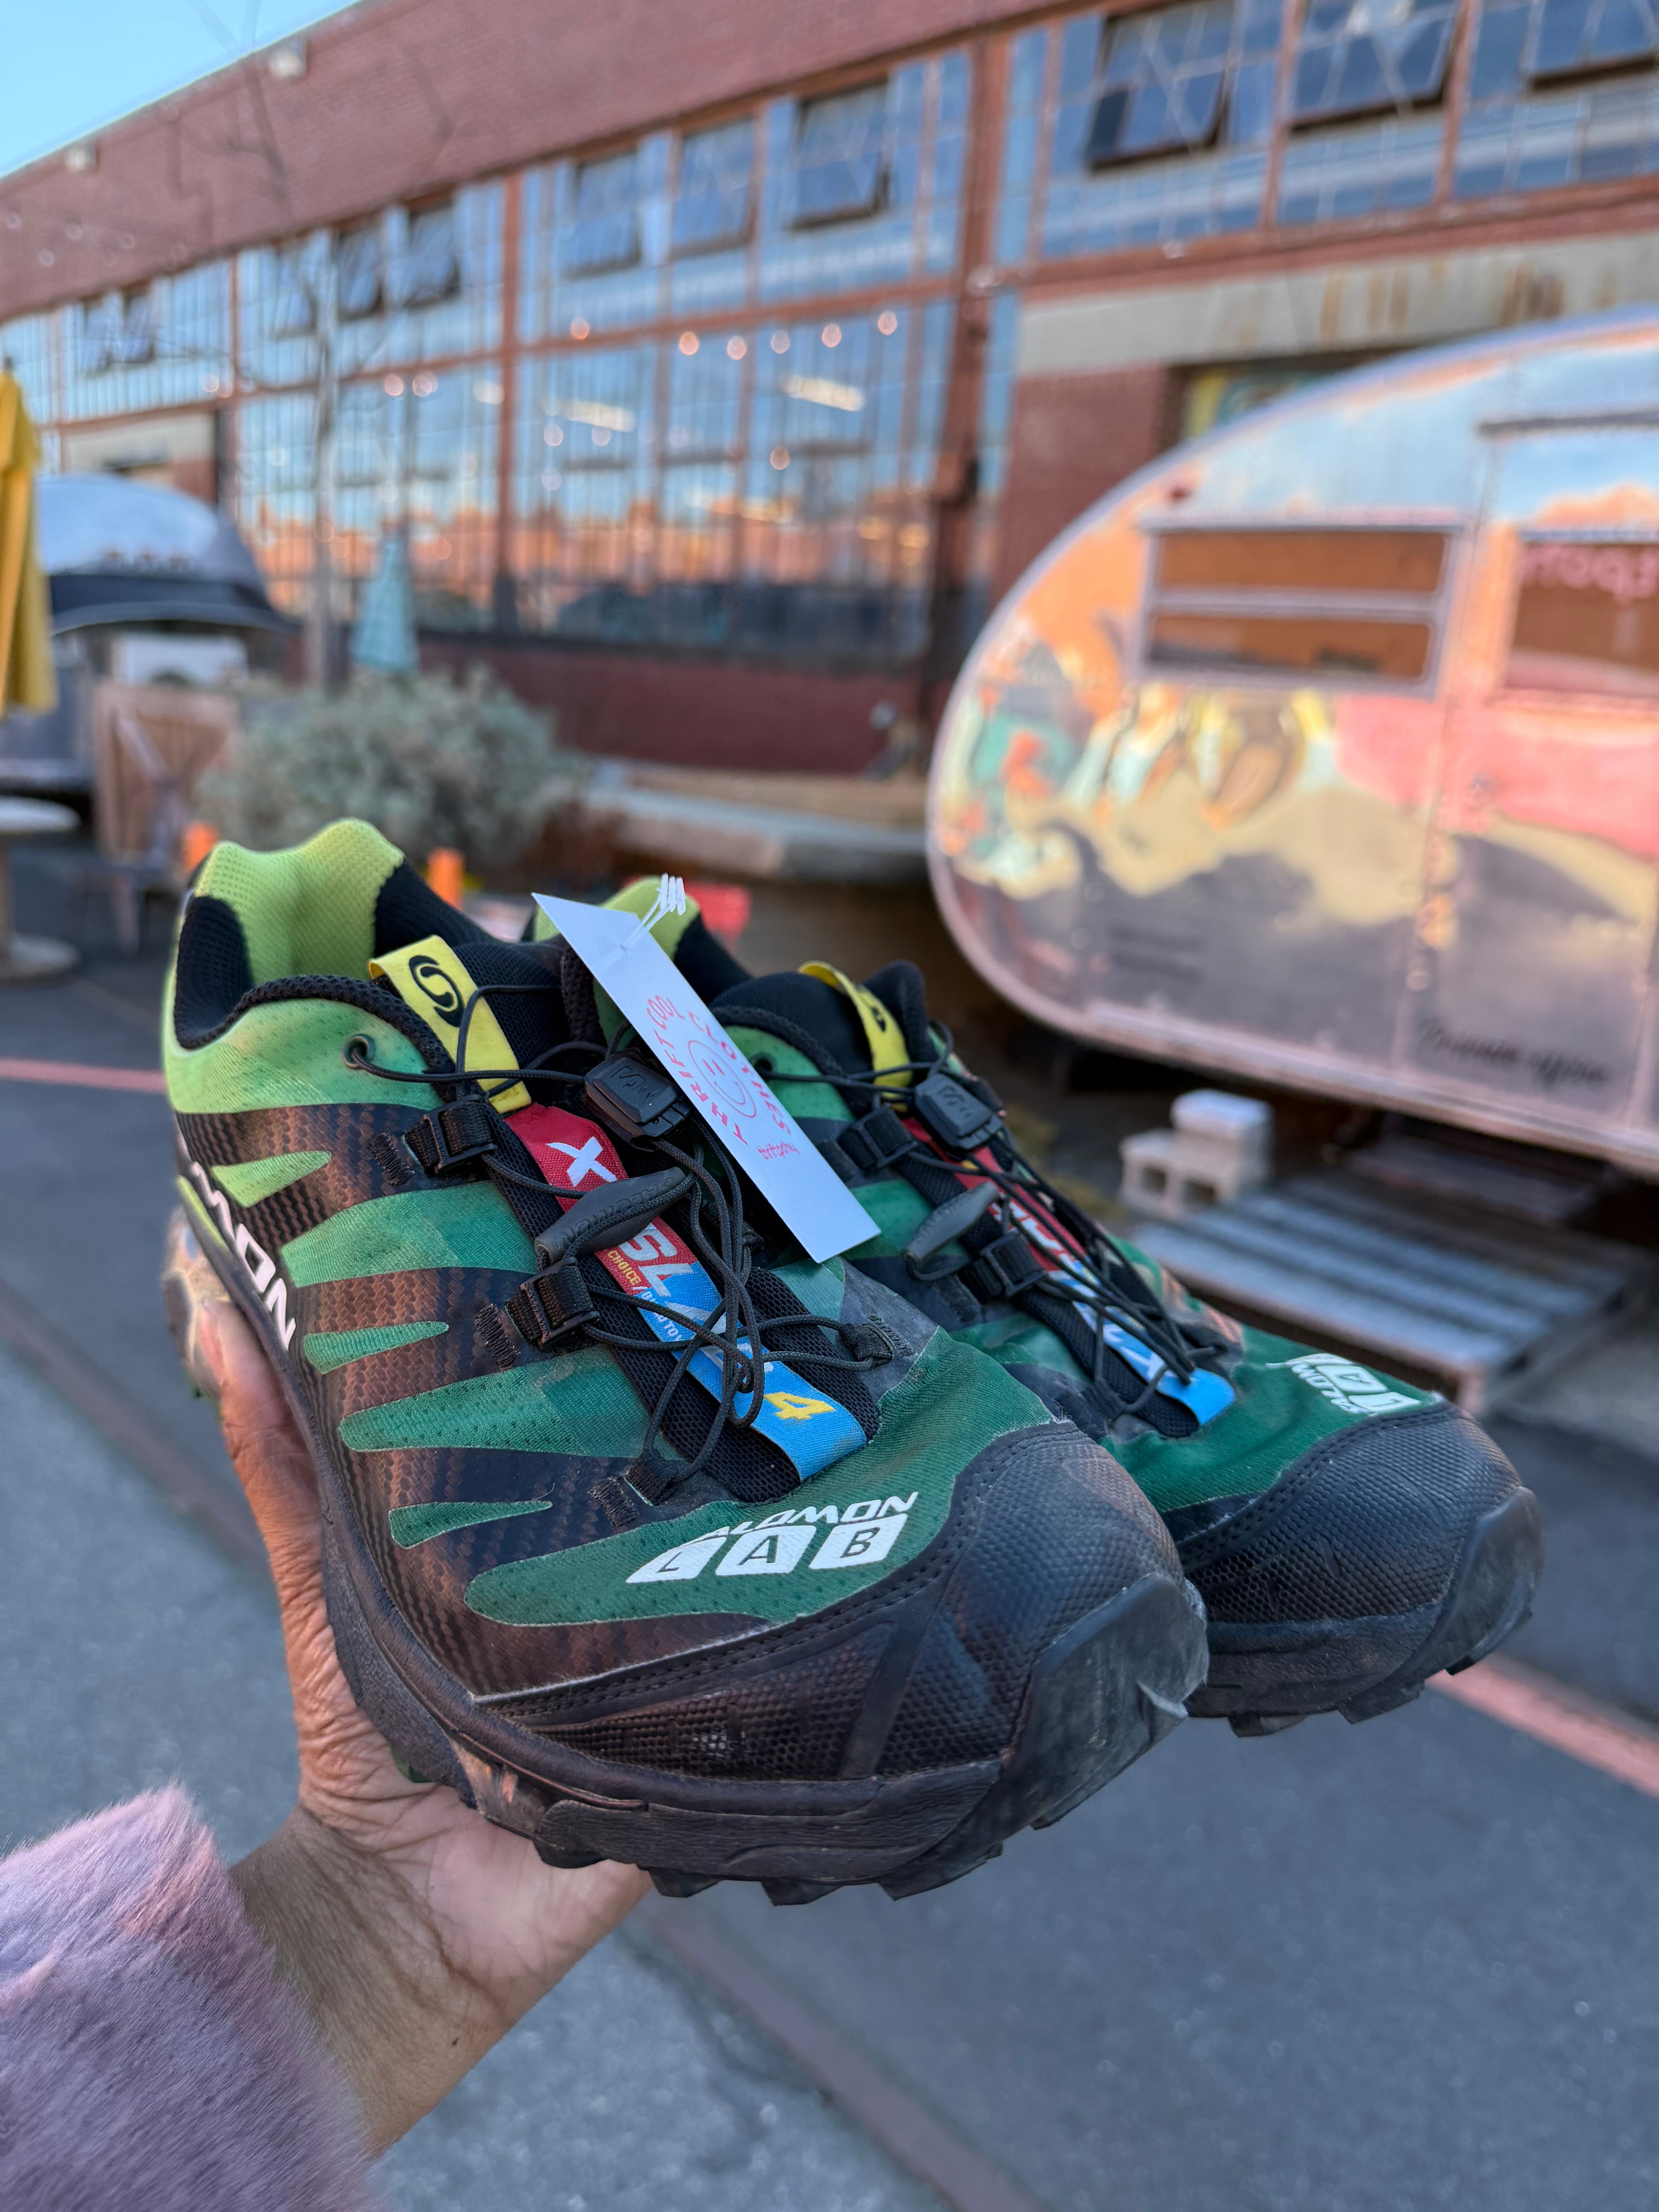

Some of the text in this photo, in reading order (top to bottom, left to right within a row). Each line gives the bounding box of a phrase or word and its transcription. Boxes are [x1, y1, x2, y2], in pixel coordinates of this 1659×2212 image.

[646, 994, 791, 1146] THRIFT COOL CLOTHES
[607, 1250, 642, 1286] CHOICE
[764, 1391, 836, 1420] 4
[676, 1492, 919, 1547] ALOMON
[651, 1523, 887, 1576] LAB
